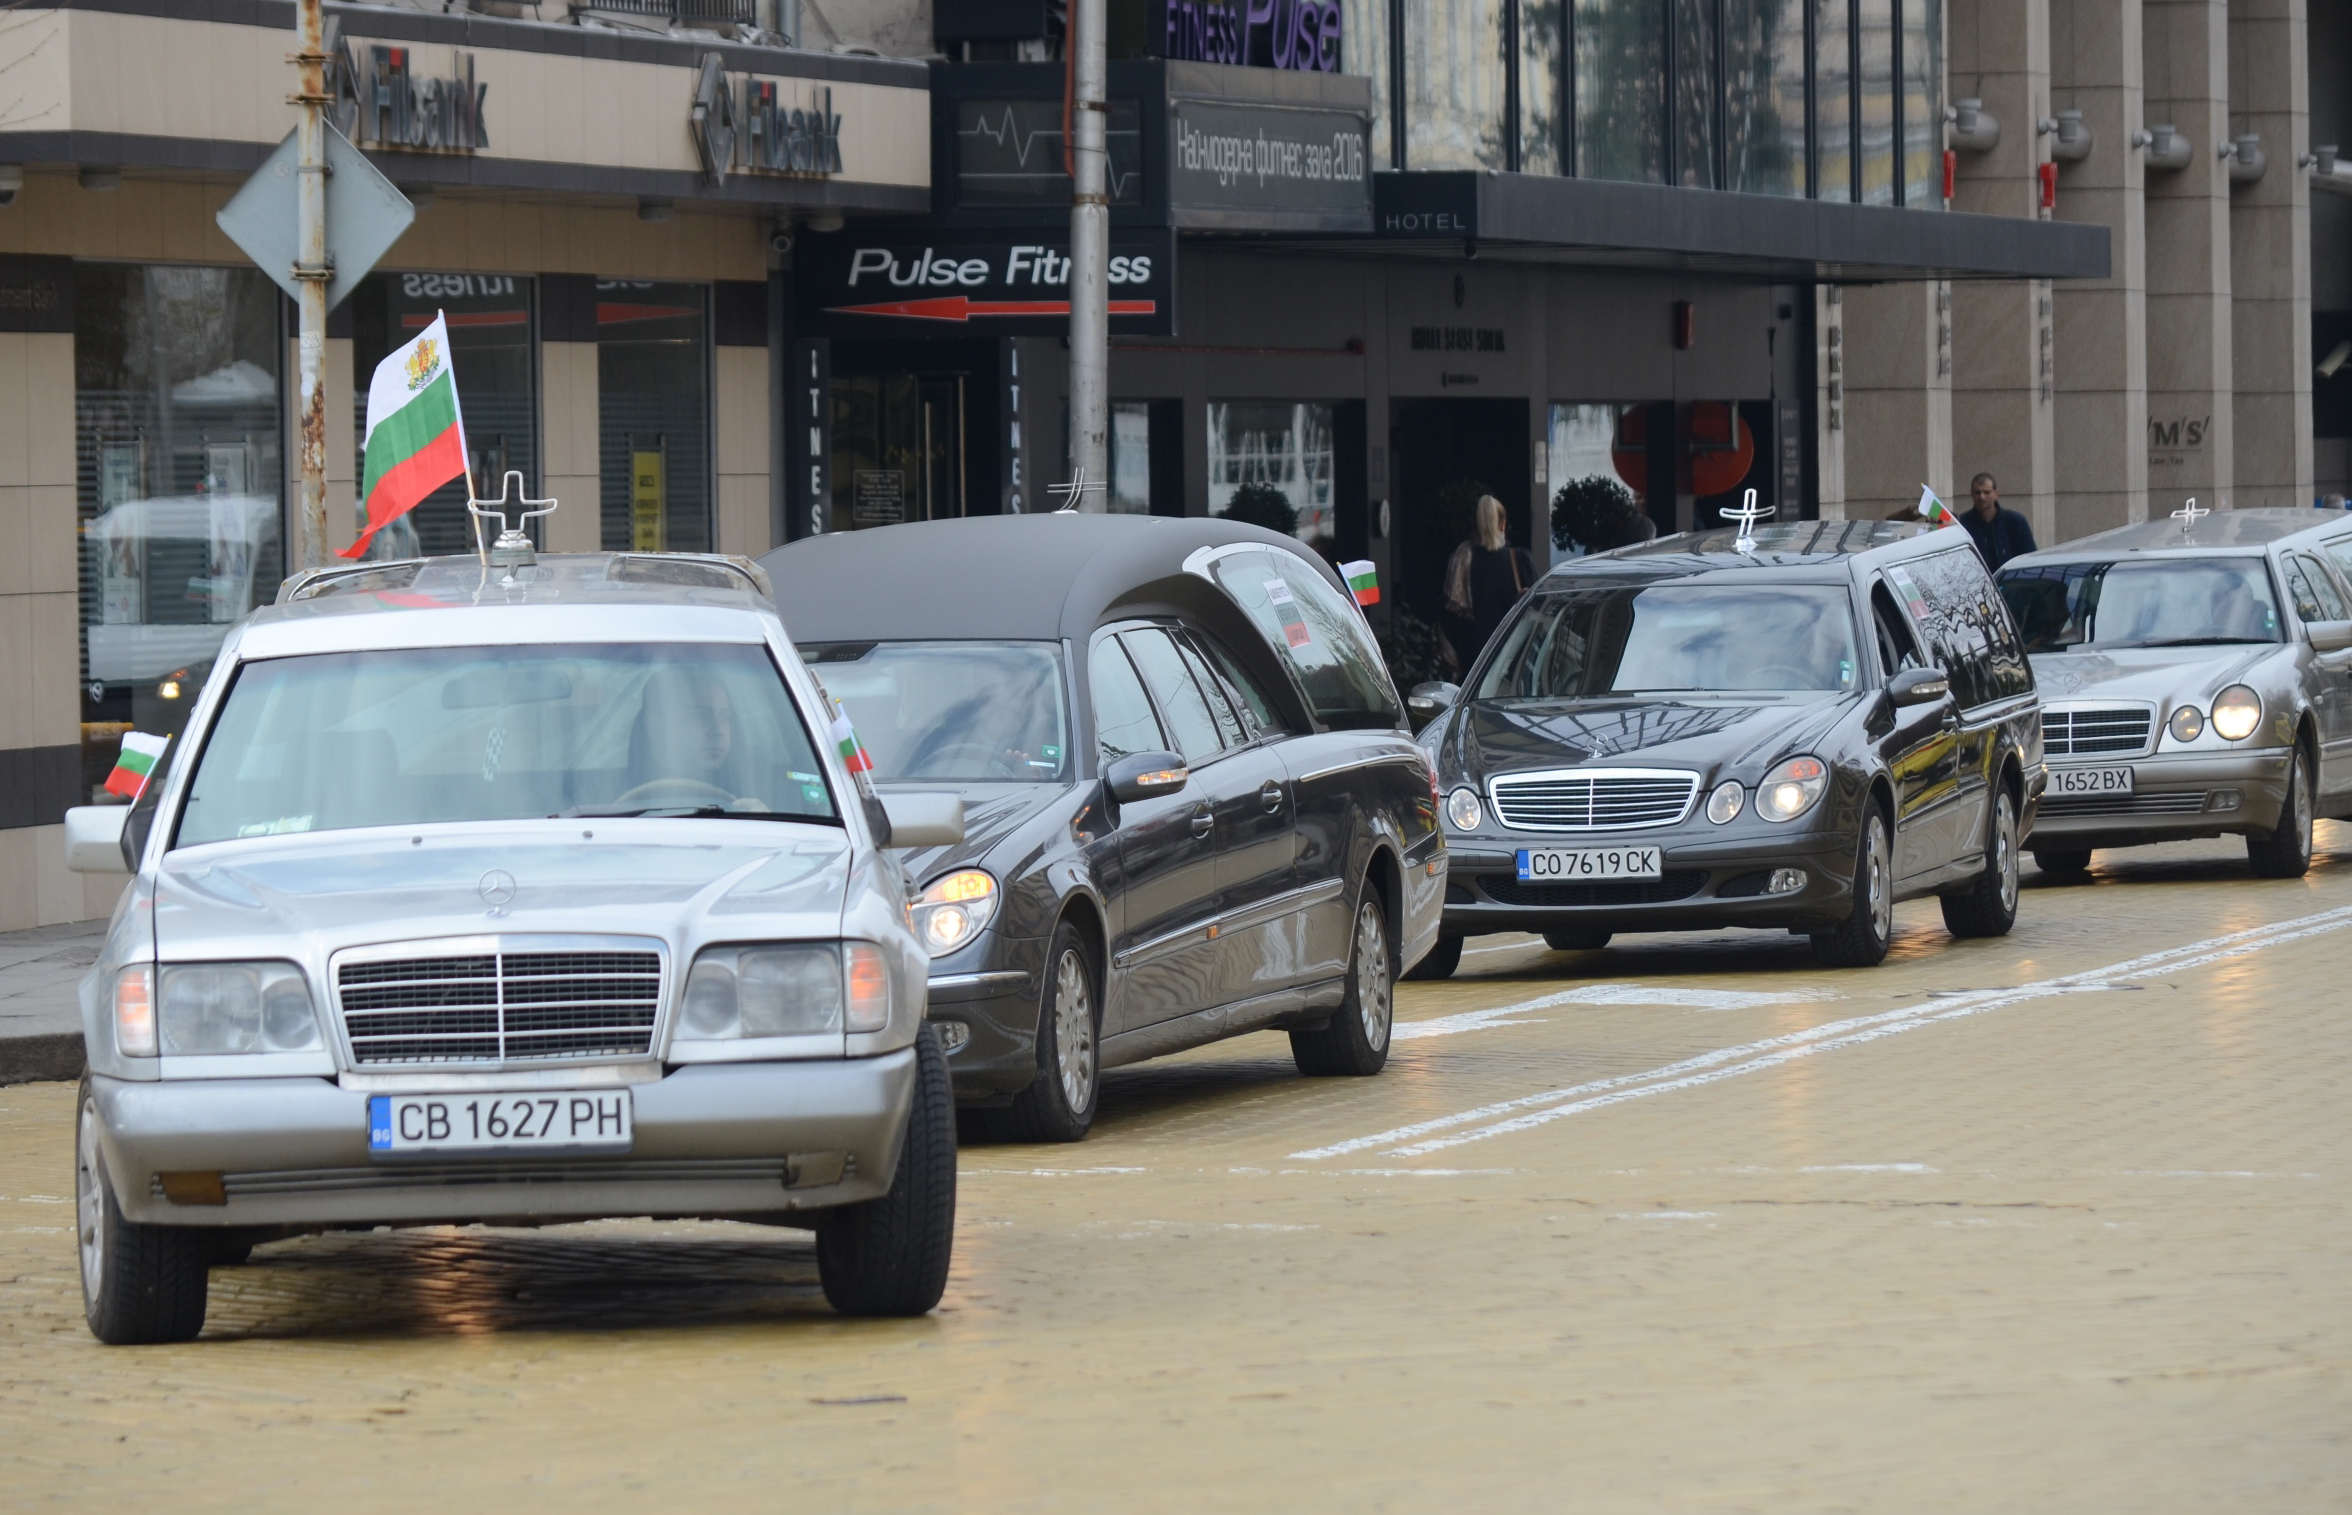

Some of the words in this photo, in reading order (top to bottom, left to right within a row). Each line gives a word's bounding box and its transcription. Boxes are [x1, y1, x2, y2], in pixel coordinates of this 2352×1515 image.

[1166, 0, 1238, 64] FITNESS
[1333, 132, 1363, 181] 2016
[1386, 213, 1466, 230] HOTEL
[848, 247, 989, 286] Pulse
[1005, 246, 1151, 285] Fitss
[2055, 771, 2100, 792] 1652
[2103, 770, 2128, 790] BX
[400, 1102, 450, 1141] CB
[466, 1098, 560, 1140] 1627
[569, 1096, 622, 1137] PH
